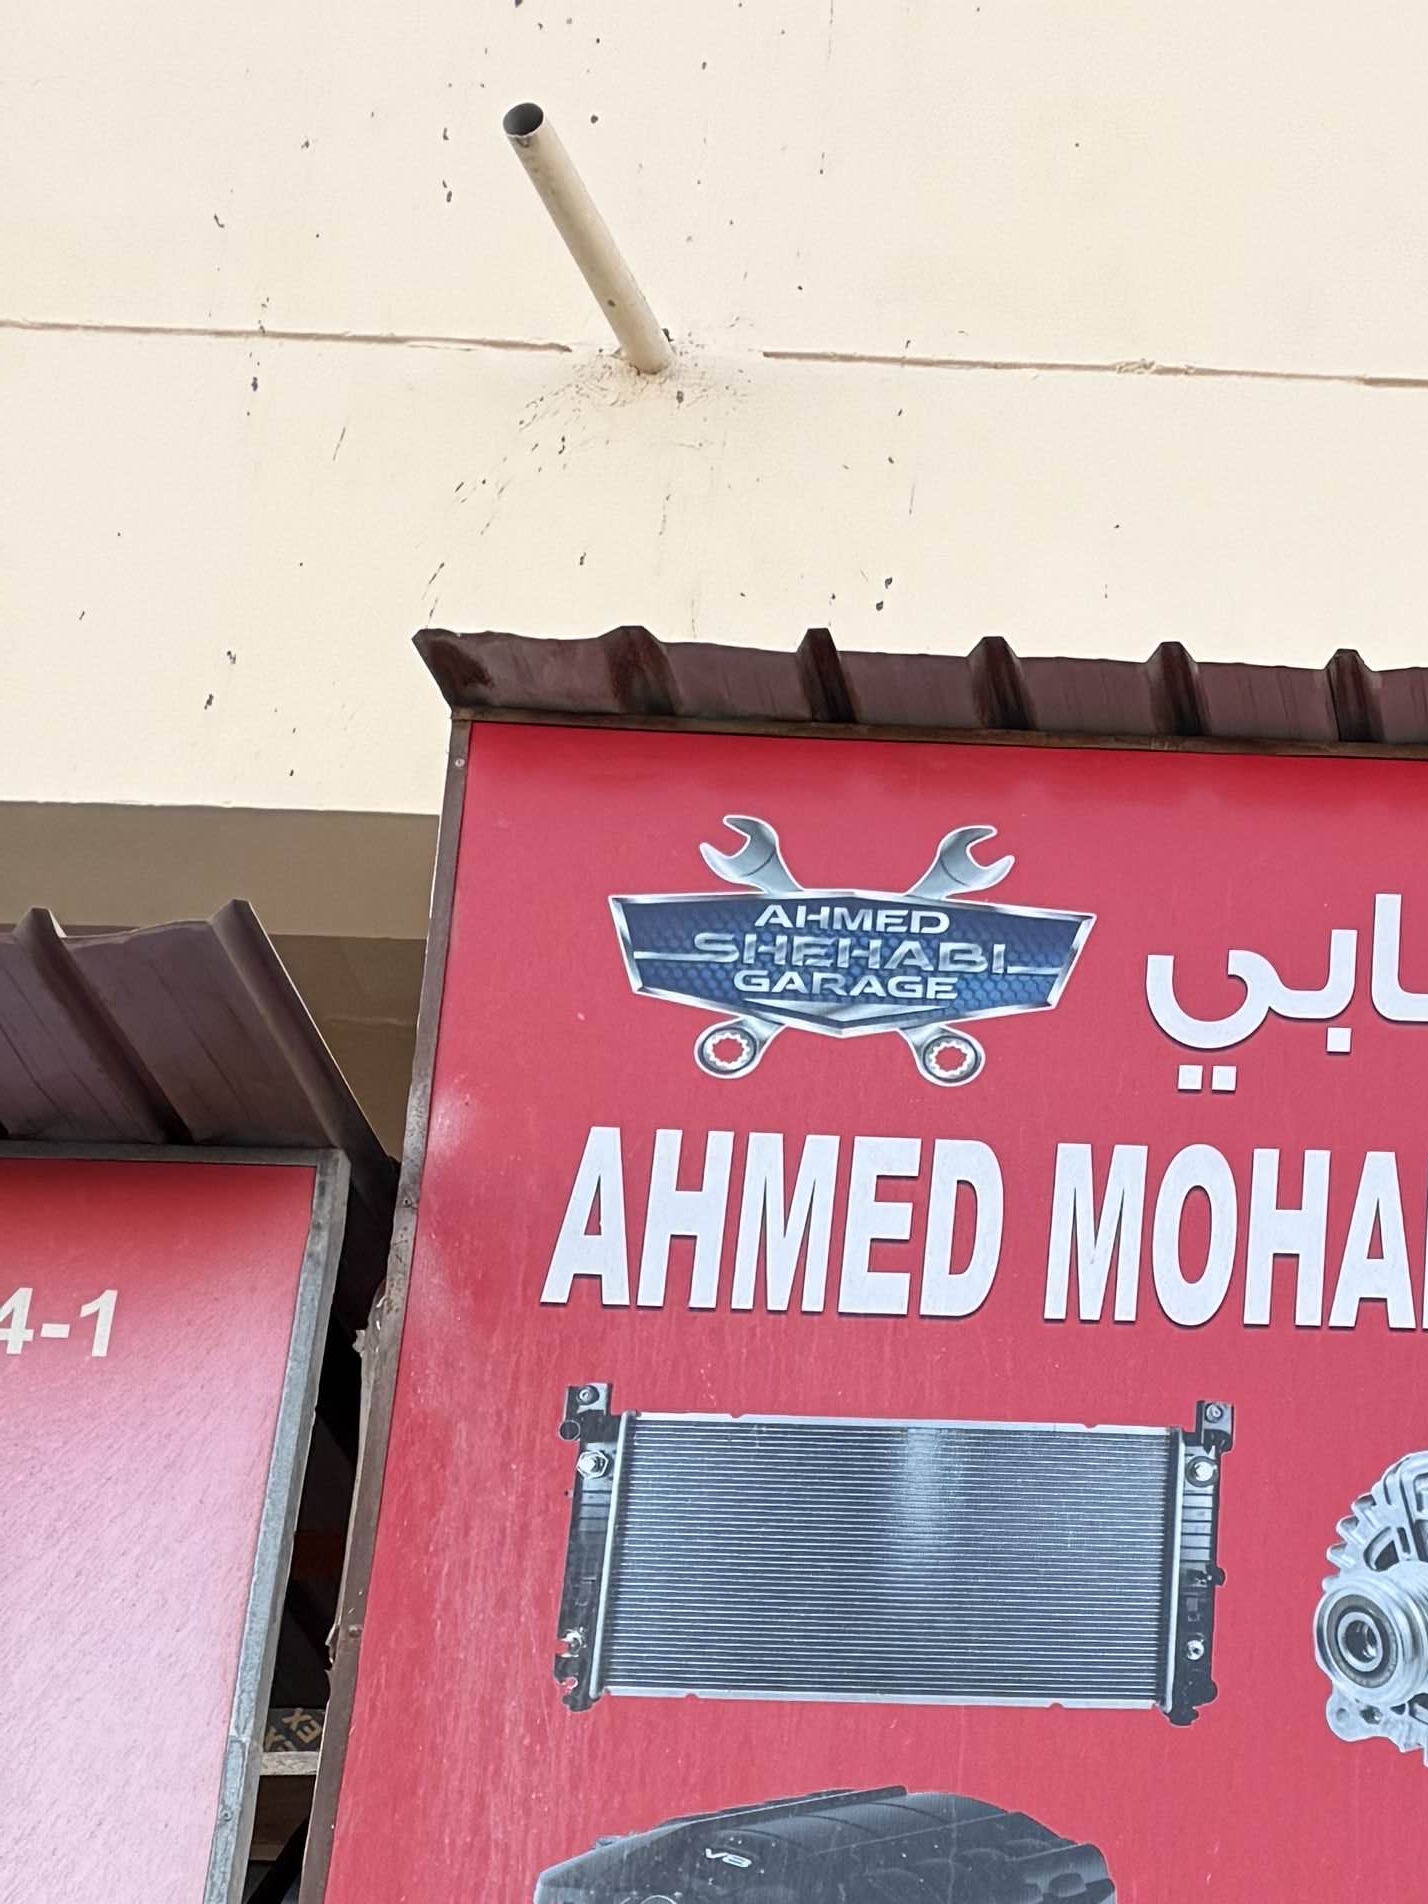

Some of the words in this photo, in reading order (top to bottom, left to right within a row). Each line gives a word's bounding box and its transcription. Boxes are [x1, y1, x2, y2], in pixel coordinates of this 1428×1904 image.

[754, 904, 951, 936] AHMED
[692, 933, 1009, 974] SHEHABI
[733, 969, 960, 1001] GARAGE
[541, 1126, 1004, 1319] AHMED
